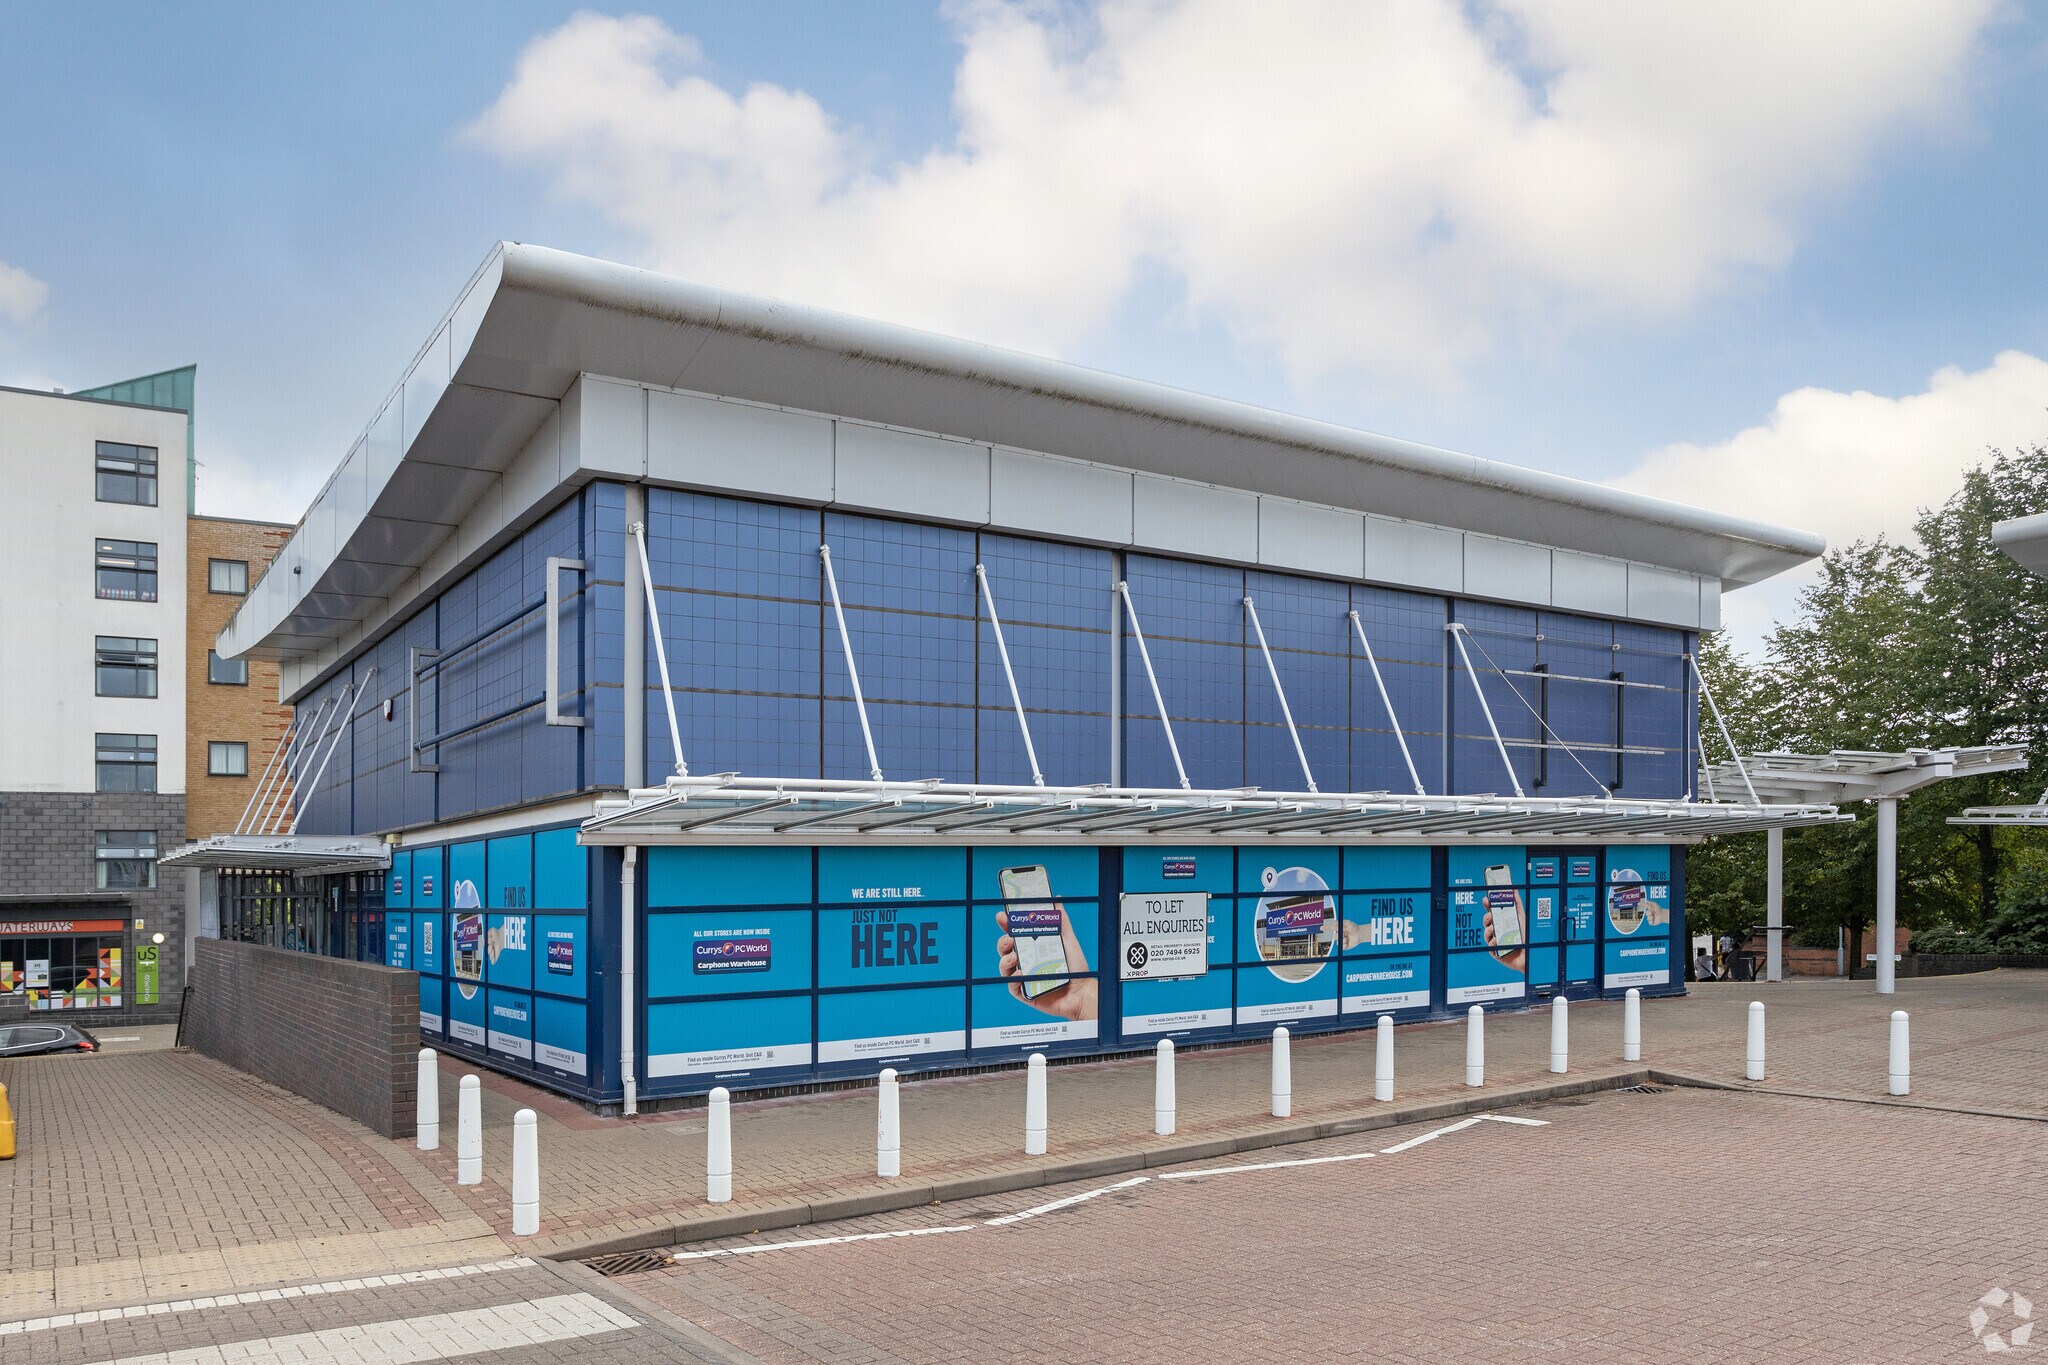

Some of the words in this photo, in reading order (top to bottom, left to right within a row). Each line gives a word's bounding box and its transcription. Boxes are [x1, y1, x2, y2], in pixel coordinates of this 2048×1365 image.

[1648, 872, 1657, 880] FIND
[1659, 871, 1666, 880] US
[504, 886, 516, 908] FIND
[518, 886, 526, 908] US
[852, 888, 864, 898] WE
[866, 888, 880, 898] ARE
[882, 888, 902, 898] STILL
[1650, 886, 1666, 899] HERE
[1146, 900, 1161, 914] TO
[1165, 900, 1183, 913] LET
[1371, 898, 1396, 916] FIND
[1400, 898, 1413, 915] US
[852, 910, 875, 923] JUST
[879, 909, 898, 922] NOT
[1268, 916, 1285, 925] Currys
[1294, 912, 1302, 921] PC
[1303, 909, 1321, 919] World
[1456, 913, 1472, 928] NOT
[504, 916, 526, 950] HERE
[1124, 921, 1143, 935] ALL
[1147, 919, 1204, 934] ENQUIRIES
[1371, 916, 1414, 945] HERE
[1456, 928, 1481, 946] HERE
[696, 946, 722, 955] Currys
[746, 944, 768, 952] World
[852, 922, 938, 968] HERE
[1346, 970, 1413, 982] CARPHONEWAREHOUSE.COM
